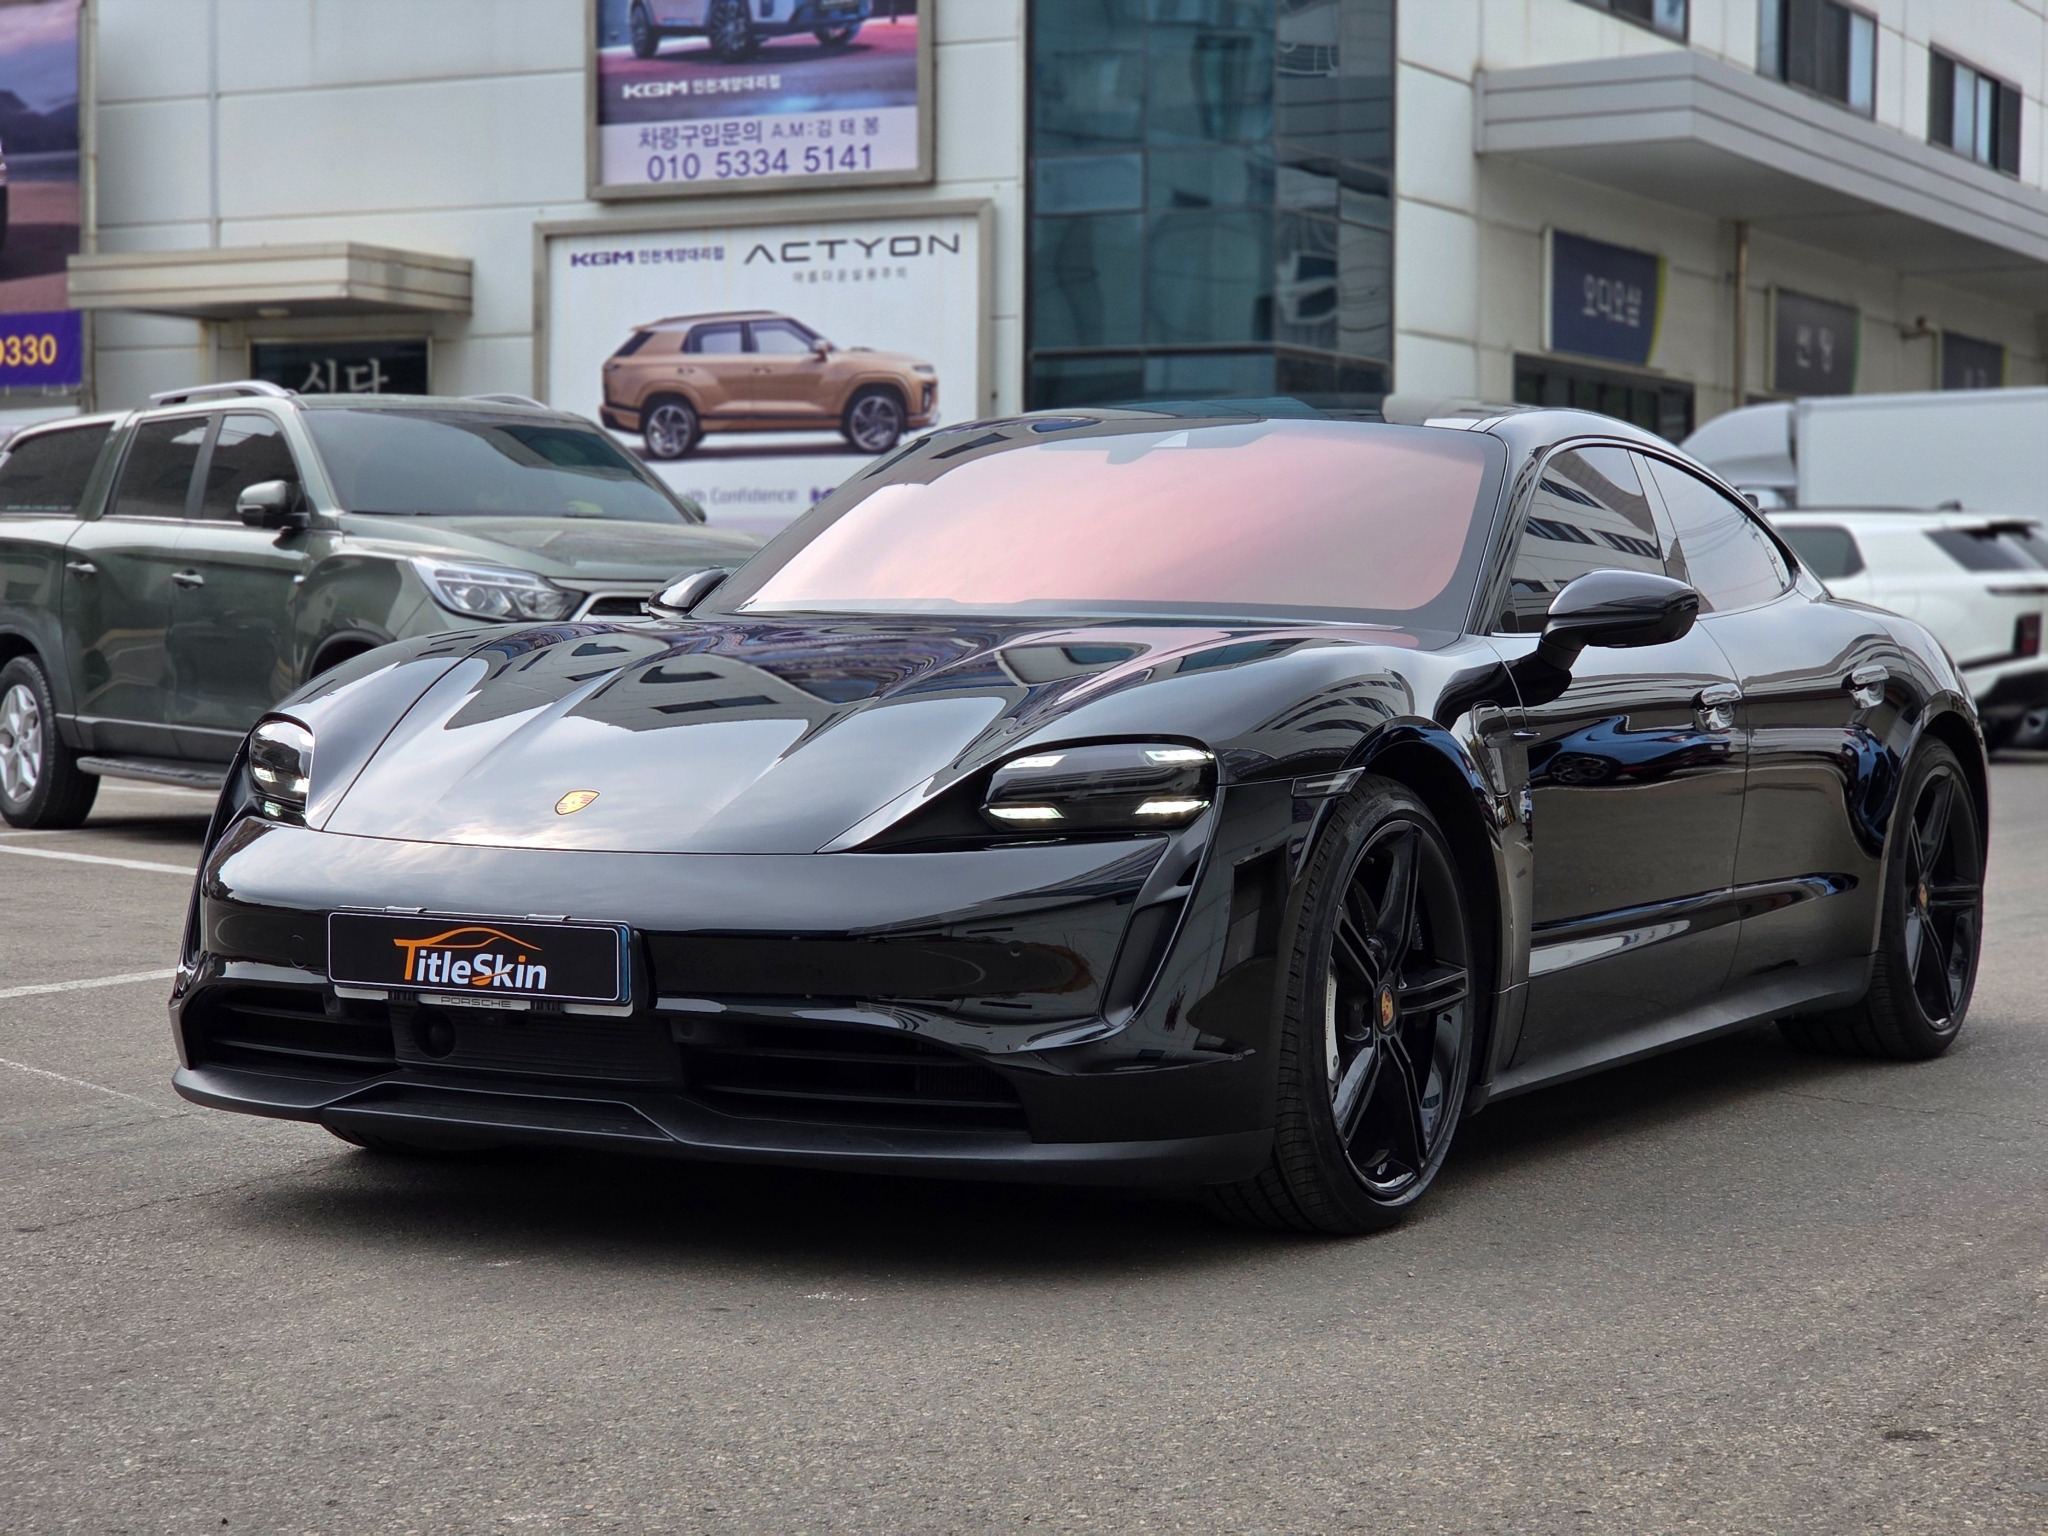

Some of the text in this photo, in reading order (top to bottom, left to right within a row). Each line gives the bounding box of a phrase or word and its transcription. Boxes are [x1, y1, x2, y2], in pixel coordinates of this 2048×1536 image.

[622, 80, 689, 99] KGM
[639, 121, 763, 150] 차량구입문의
[646, 143, 872, 182] 010 5334 5141
[570, 250, 634, 267] KGM
[744, 233, 960, 265] ACTYON
[0, 334, 57, 368] 330
[394, 936, 548, 991] TitleSkin
[440, 996, 512, 1008] PORSCHE
